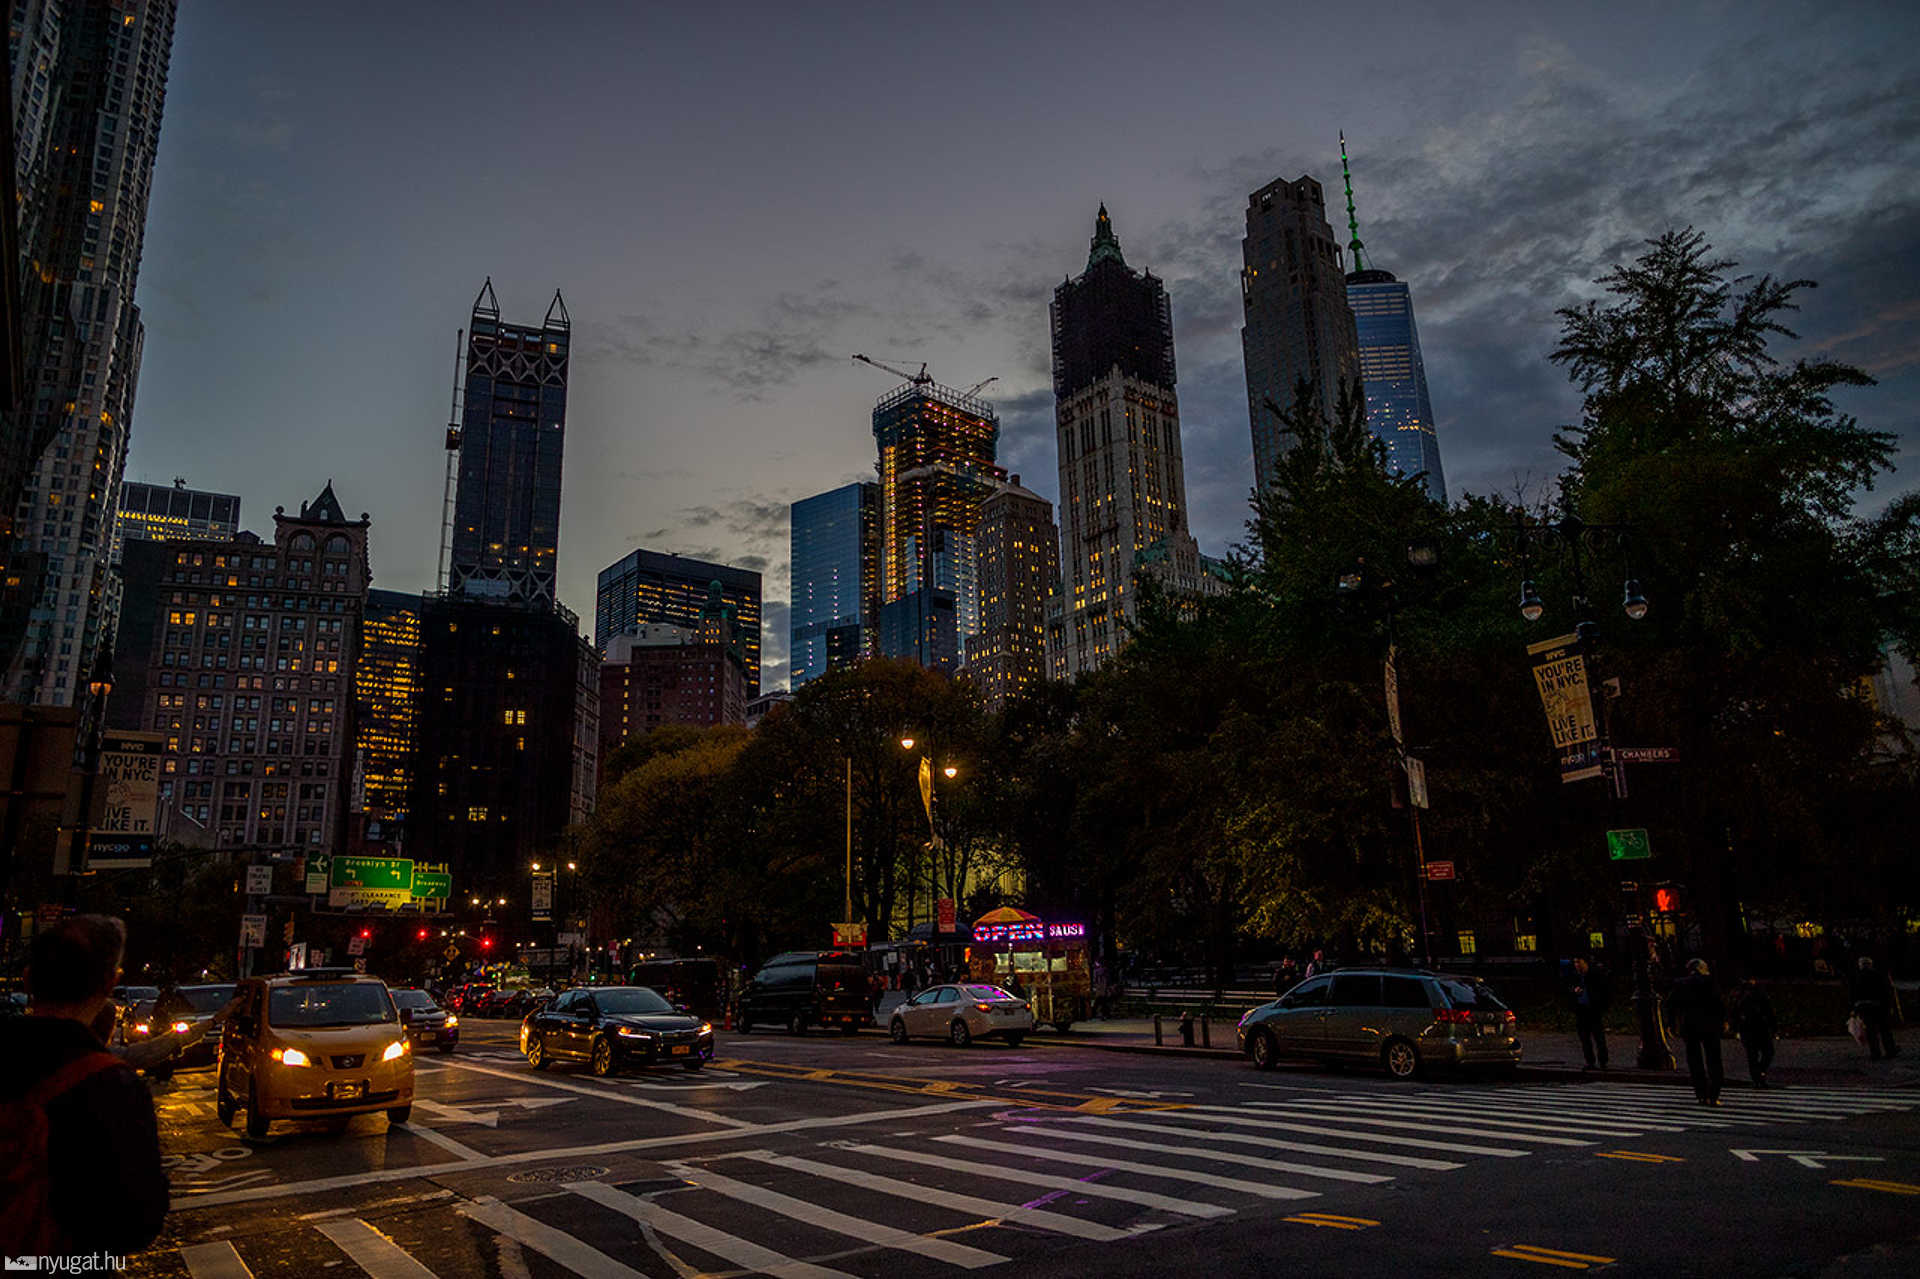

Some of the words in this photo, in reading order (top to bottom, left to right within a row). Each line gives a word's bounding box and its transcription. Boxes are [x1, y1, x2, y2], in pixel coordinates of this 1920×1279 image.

[1537, 658, 1582, 680] YOU'RE
[1541, 680, 1554, 693] IN
[1552, 715, 1577, 731] LIVE
[1555, 728, 1578, 744] LIKE
[104, 754, 157, 769] YOU'RE
[103, 767, 118, 780] IN
[122, 769, 155, 781] NYC.
[973, 923, 1044, 942] OPEN
